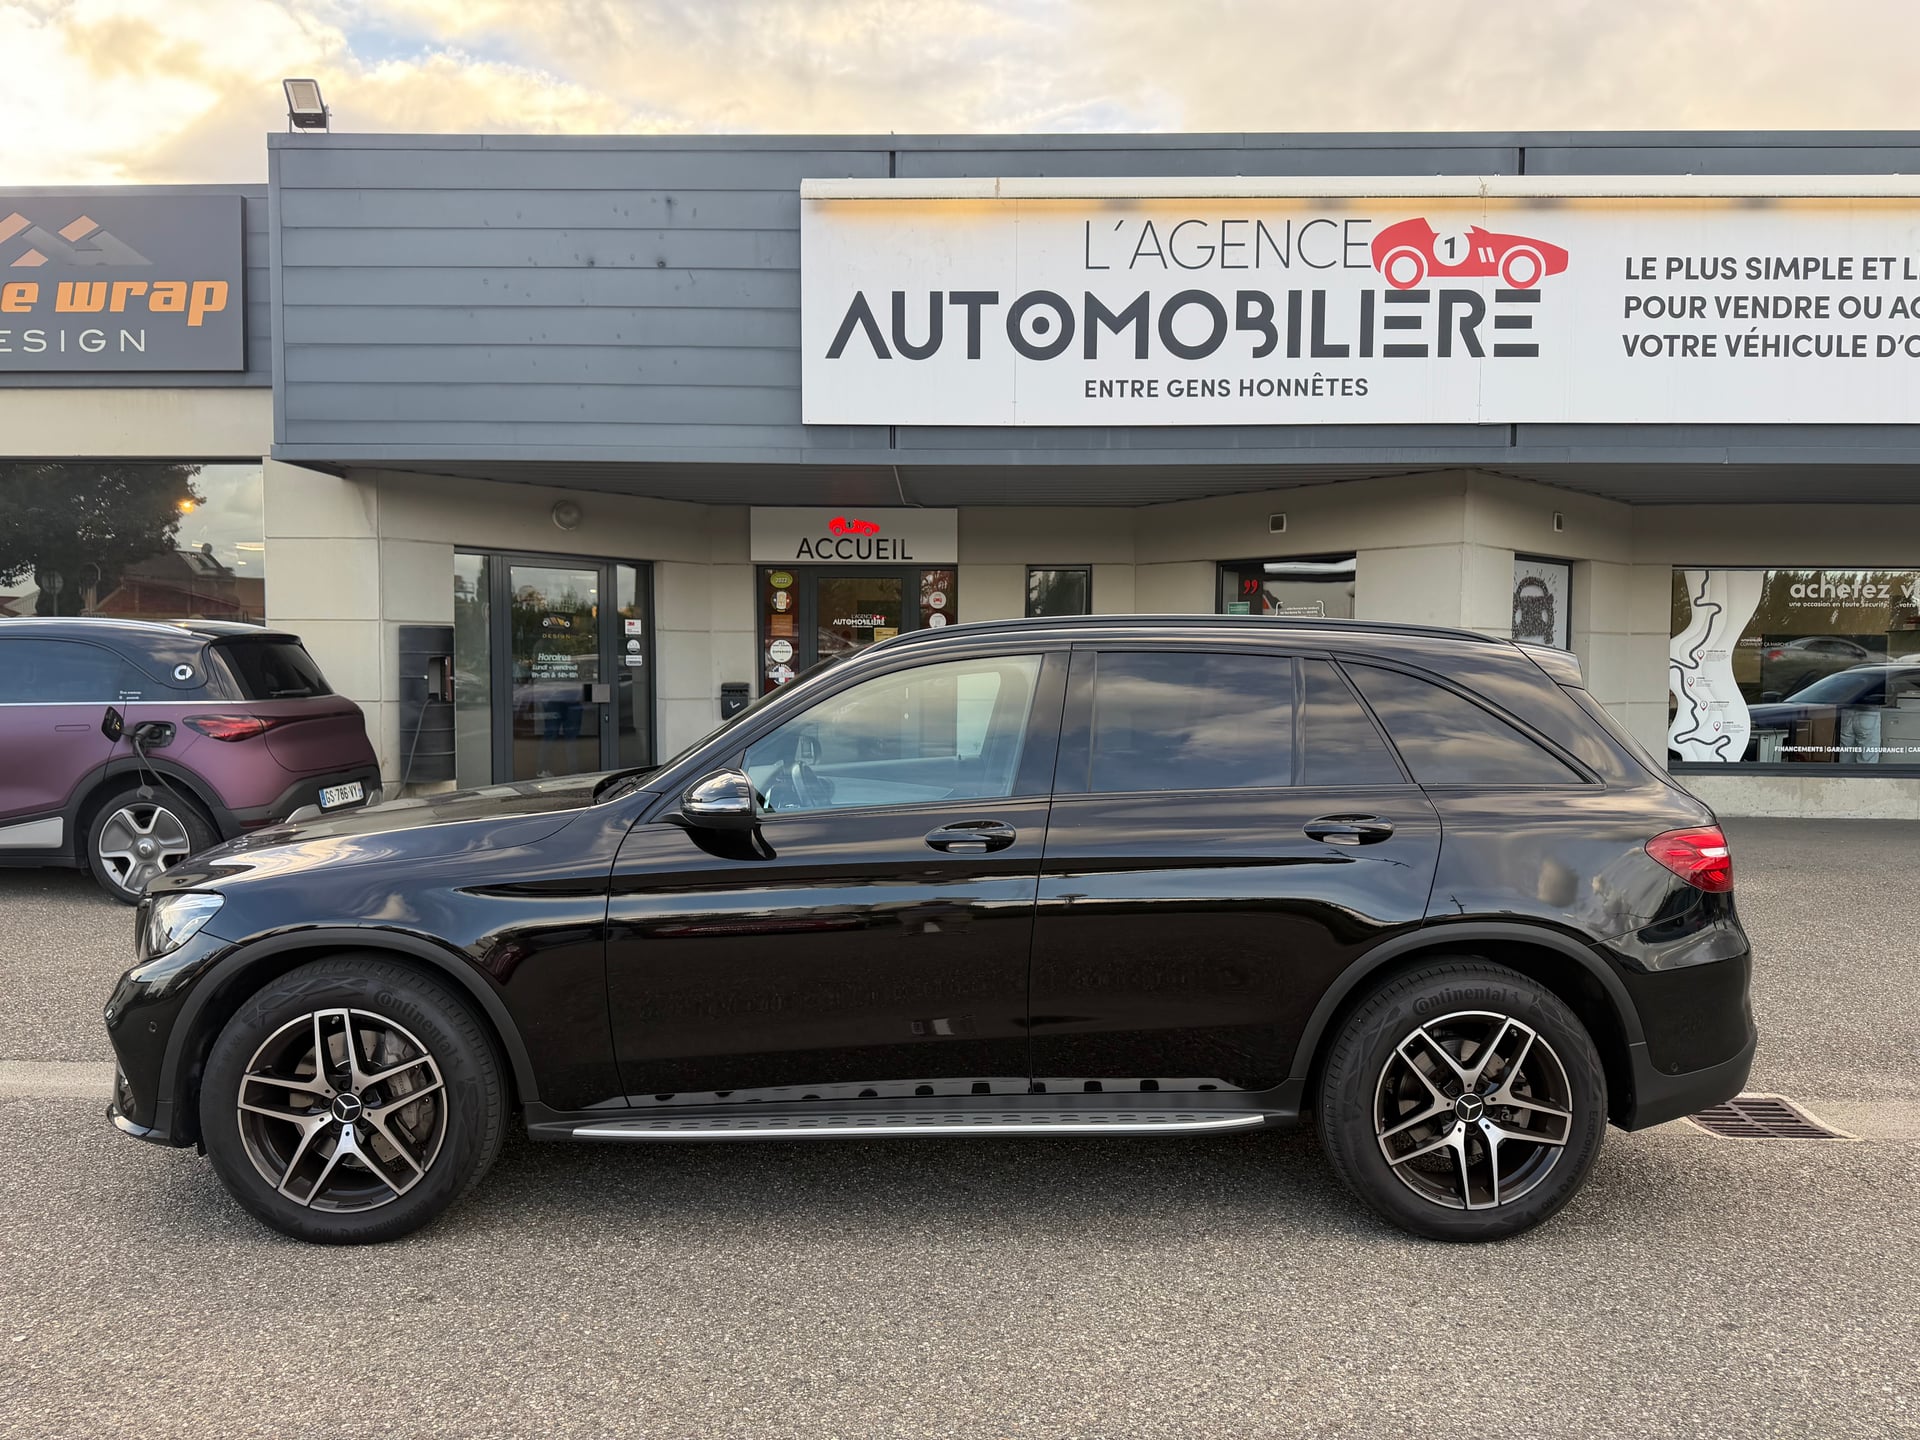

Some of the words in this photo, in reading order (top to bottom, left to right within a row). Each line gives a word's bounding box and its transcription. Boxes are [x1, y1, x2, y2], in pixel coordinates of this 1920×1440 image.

[1444, 236, 1456, 259] 1
[1625, 256, 1658, 280] LE
[1665, 256, 1737, 280] PLUS
[1745, 256, 1853, 280] SIMPLE
[1862, 256, 1896, 280] ET
[1903, 256, 1920, 280] L
[55, 280, 229, 327] wrap
[1624, 295, 1706, 319] POUR
[1714, 295, 1830, 319] VENDRE
[1838, 295, 1882, 319] OU
[1622, 334, 1717, 358] VOTRE
[1724, 326, 1868, 358] VÉHICULE
[1084, 379, 1159, 398] ENTRE
[1166, 378, 1231, 398] GENS
[1239, 371, 1369, 397] HONNÊTES
[796, 537, 913, 560] ACCUEIL
[1790, 571, 1890, 598] achetez
[1774, 745, 1823, 753] FINANCEMENTS
[1826, 745, 1862, 753] GARANTIES
[1865, 746, 1904, 754] ASSURANCE
[1412, 987, 1507, 1016] Continental
[374, 990, 458, 1056] Continental
